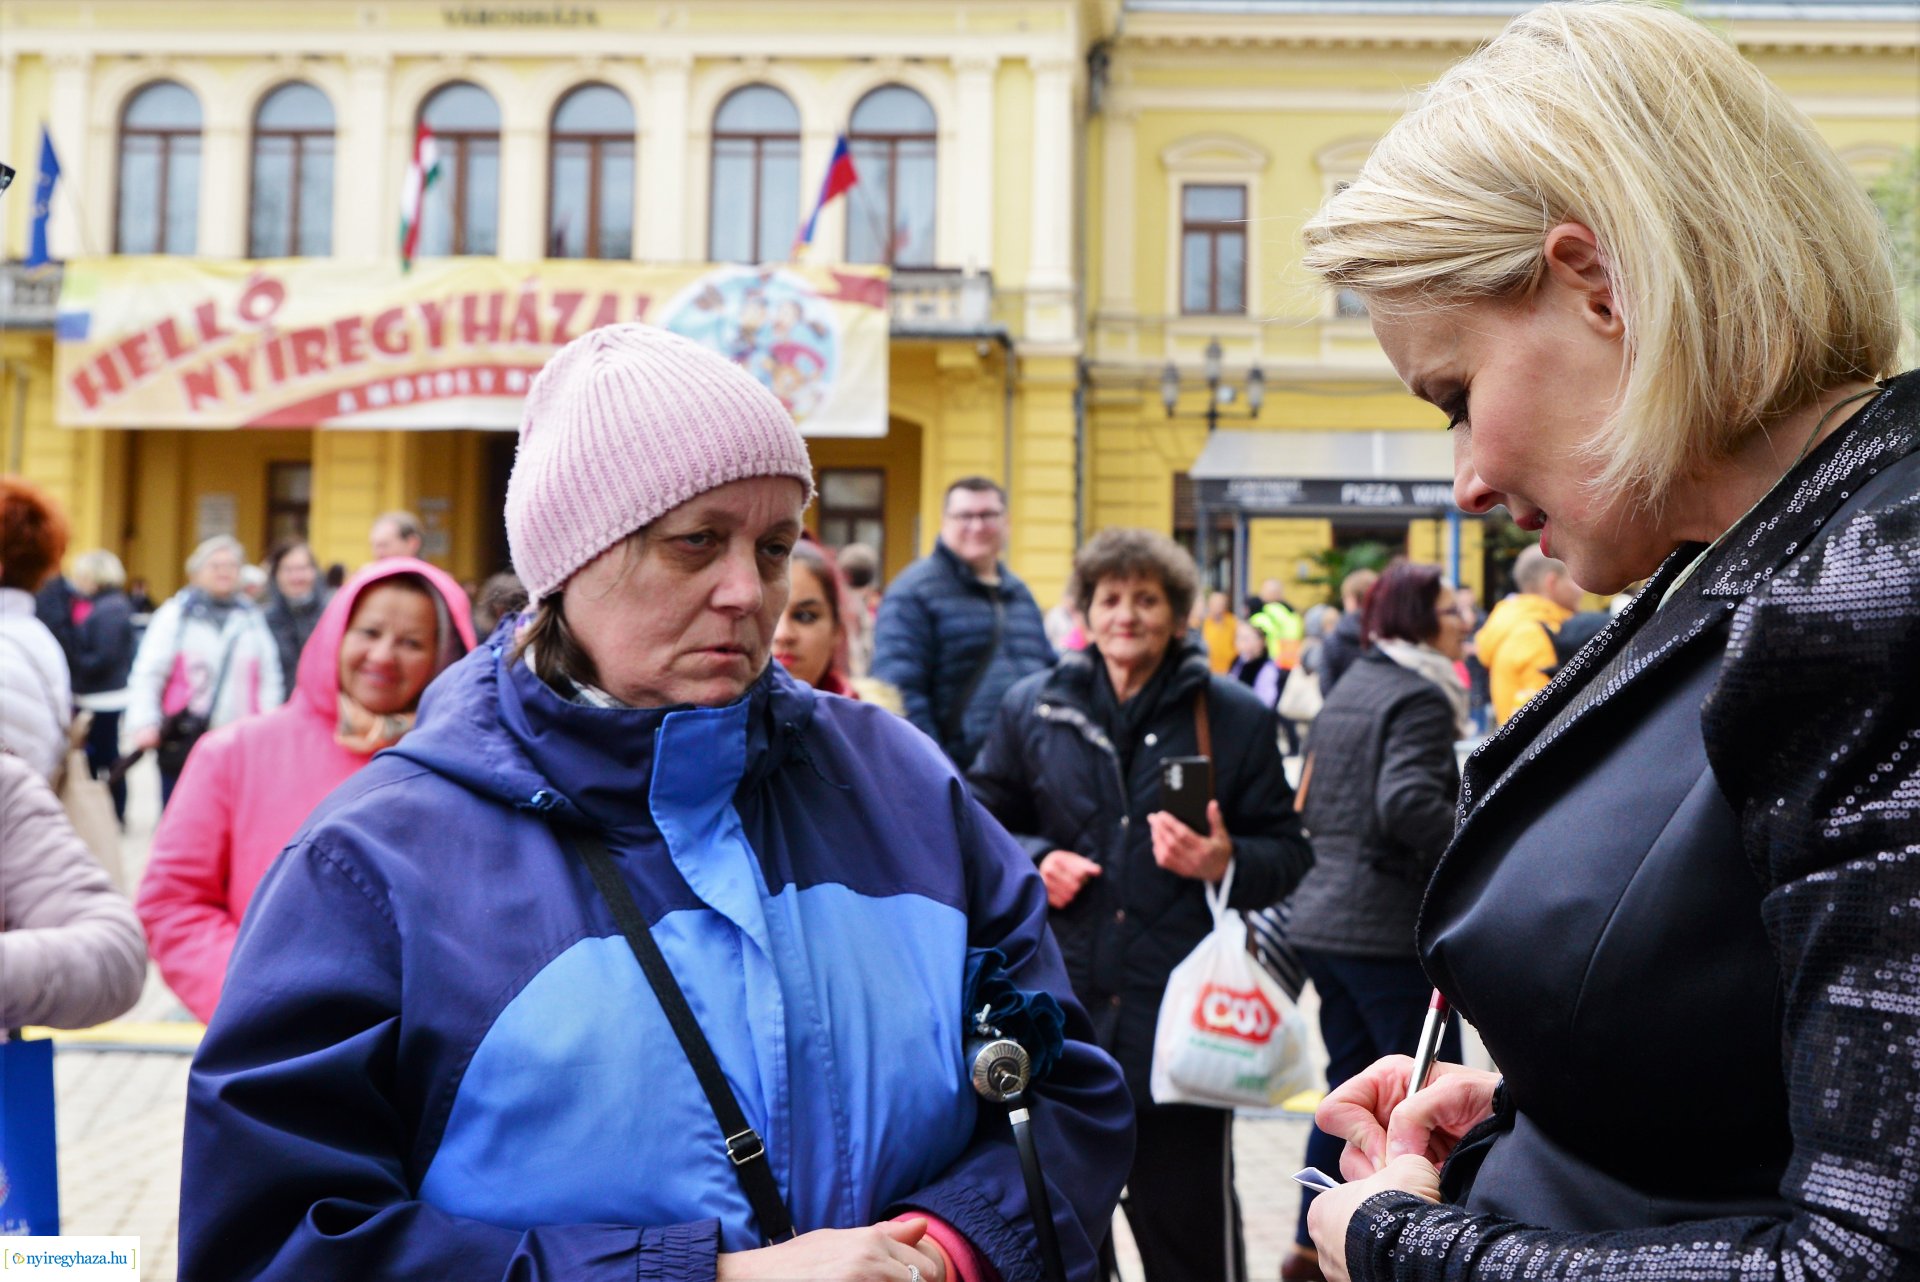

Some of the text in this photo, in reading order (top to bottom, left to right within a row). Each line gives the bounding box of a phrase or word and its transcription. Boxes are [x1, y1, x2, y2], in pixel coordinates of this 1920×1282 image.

[71, 272, 284, 411] HELLÓ
[182, 277, 651, 412] NYÍREGYHÁZA!
[337, 390, 357, 414] A
[1340, 483, 1403, 506] PIZZA
